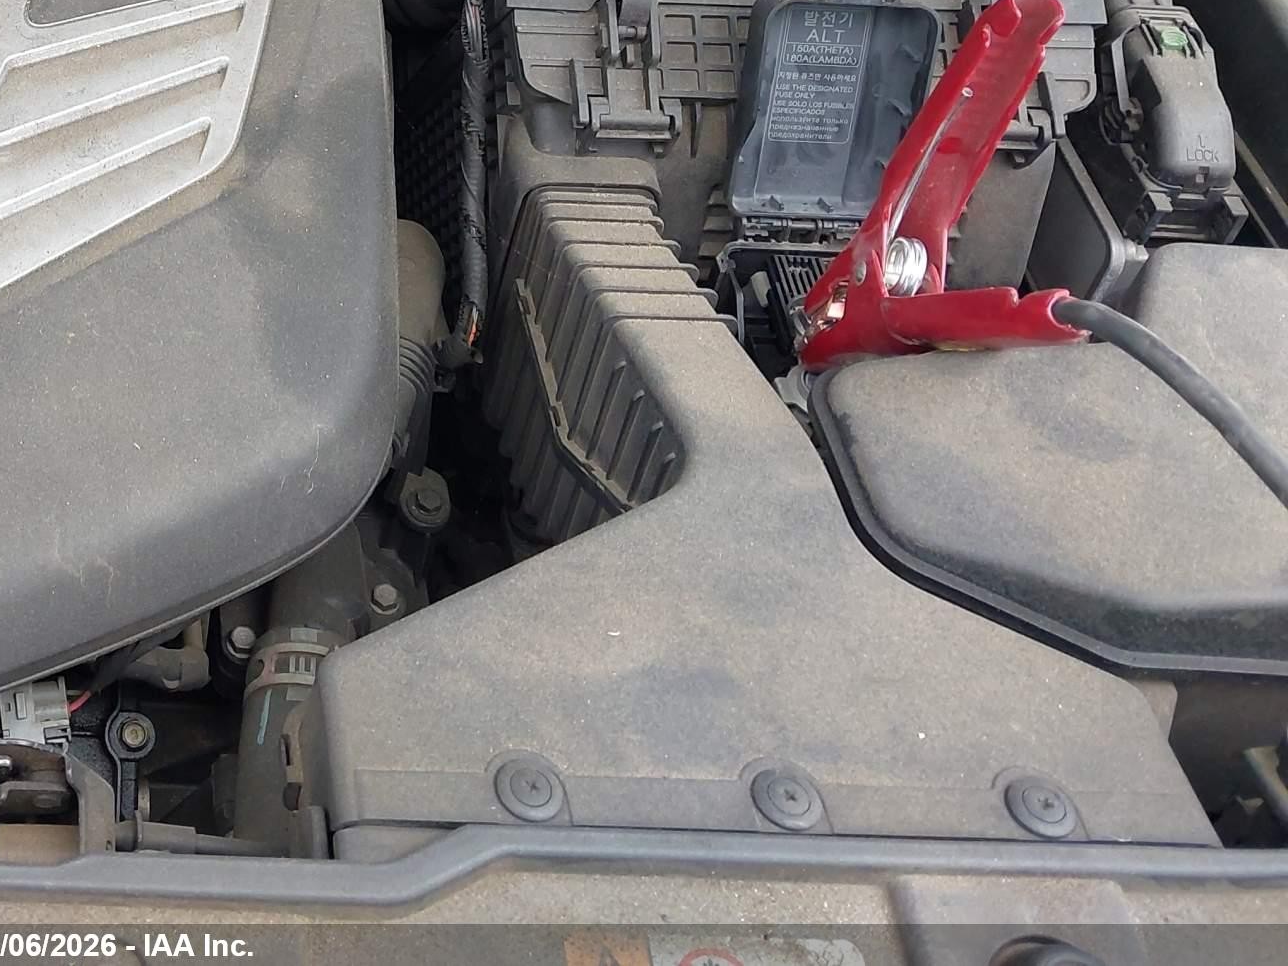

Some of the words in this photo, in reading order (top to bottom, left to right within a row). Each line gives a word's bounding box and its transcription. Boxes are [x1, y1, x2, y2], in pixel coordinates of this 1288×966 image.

[804, 10, 853, 28] 발전기
[806, 29, 846, 44] ALT
[776, 83, 790, 91] USE
[808, 85, 854, 93] DESIGNATED
[788, 100, 808, 108] SOLO
[1186, 146, 1220, 163] LOCK
